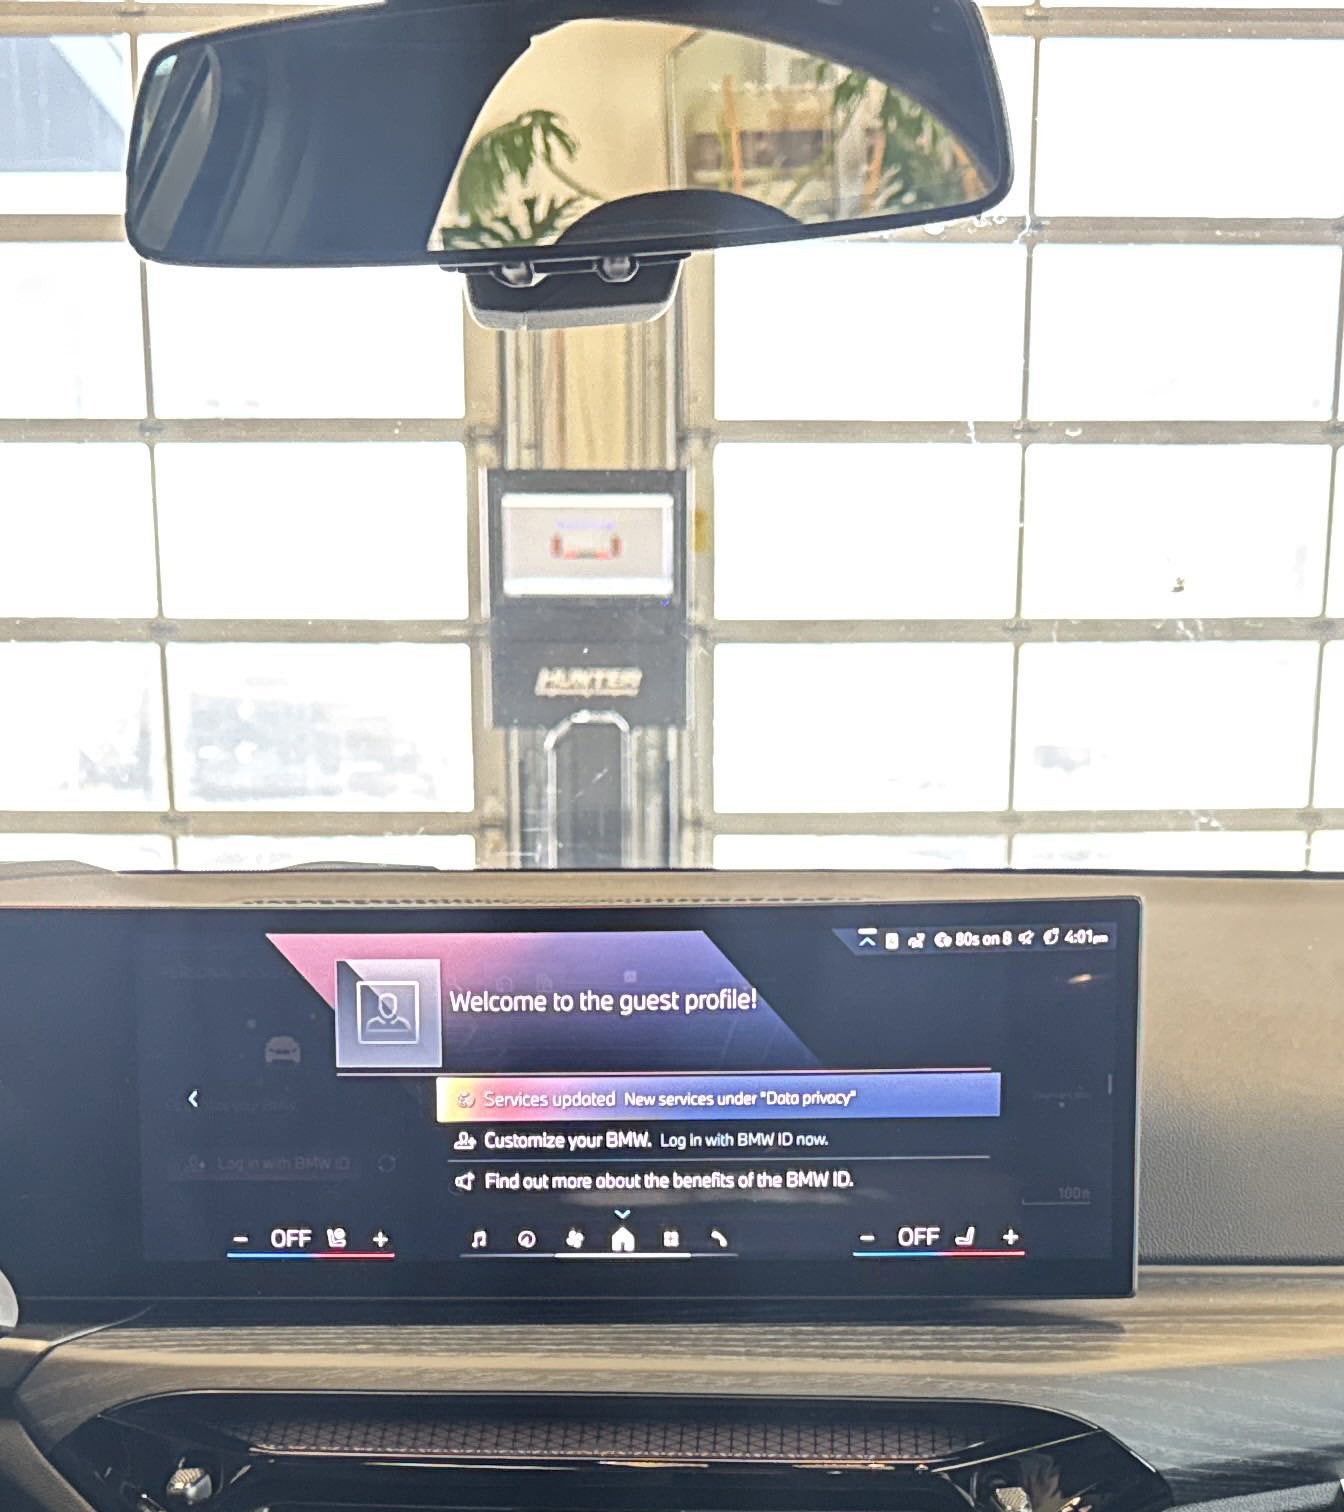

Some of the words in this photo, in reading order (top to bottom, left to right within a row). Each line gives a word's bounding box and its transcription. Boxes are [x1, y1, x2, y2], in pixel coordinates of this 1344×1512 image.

[982, 933, 999, 946] on
[1003, 930, 1012, 946] 8
[449, 990, 547, 1012] Welcome
[552, 991, 574, 1012] to
[579, 990, 614, 1012] the
[619, 991, 680, 1016] guest
[685, 987, 758, 1015] profile!
[483, 1091, 549, 1107] Services
[552, 1090, 617, 1109] updated
[624, 1091, 656, 1106] New
[658, 1091, 714, 1107] services
[717, 1091, 757, 1106] under
[484, 1130, 566, 1149] Customize
[568, 1135, 604, 1152] your
[605, 1130, 653, 1149] BMW.
[660, 1132, 687, 1151] Log
[689, 1132, 702, 1148] in
[705, 1132, 735, 1148] with
[737, 1131, 776, 1147] BMW
[778, 1131, 794, 1147] ID
[796, 1134, 830, 1147] now.
[484, 1171, 521, 1190] Find
[522, 1173, 550, 1190] out
[552, 1175, 593, 1190] more
[595, 1172, 642, 1190] about
[643, 1171, 670, 1188] the
[672, 1171, 735, 1189] benefits
[737, 1170, 756, 1188] of
[756, 1170, 783, 1188] the
[785, 1169, 830, 1189] BMW
[832, 1169, 855, 1188] ID.
[269, 1228, 313, 1249] OFF
[897, 1226, 941, 1247] OFF
